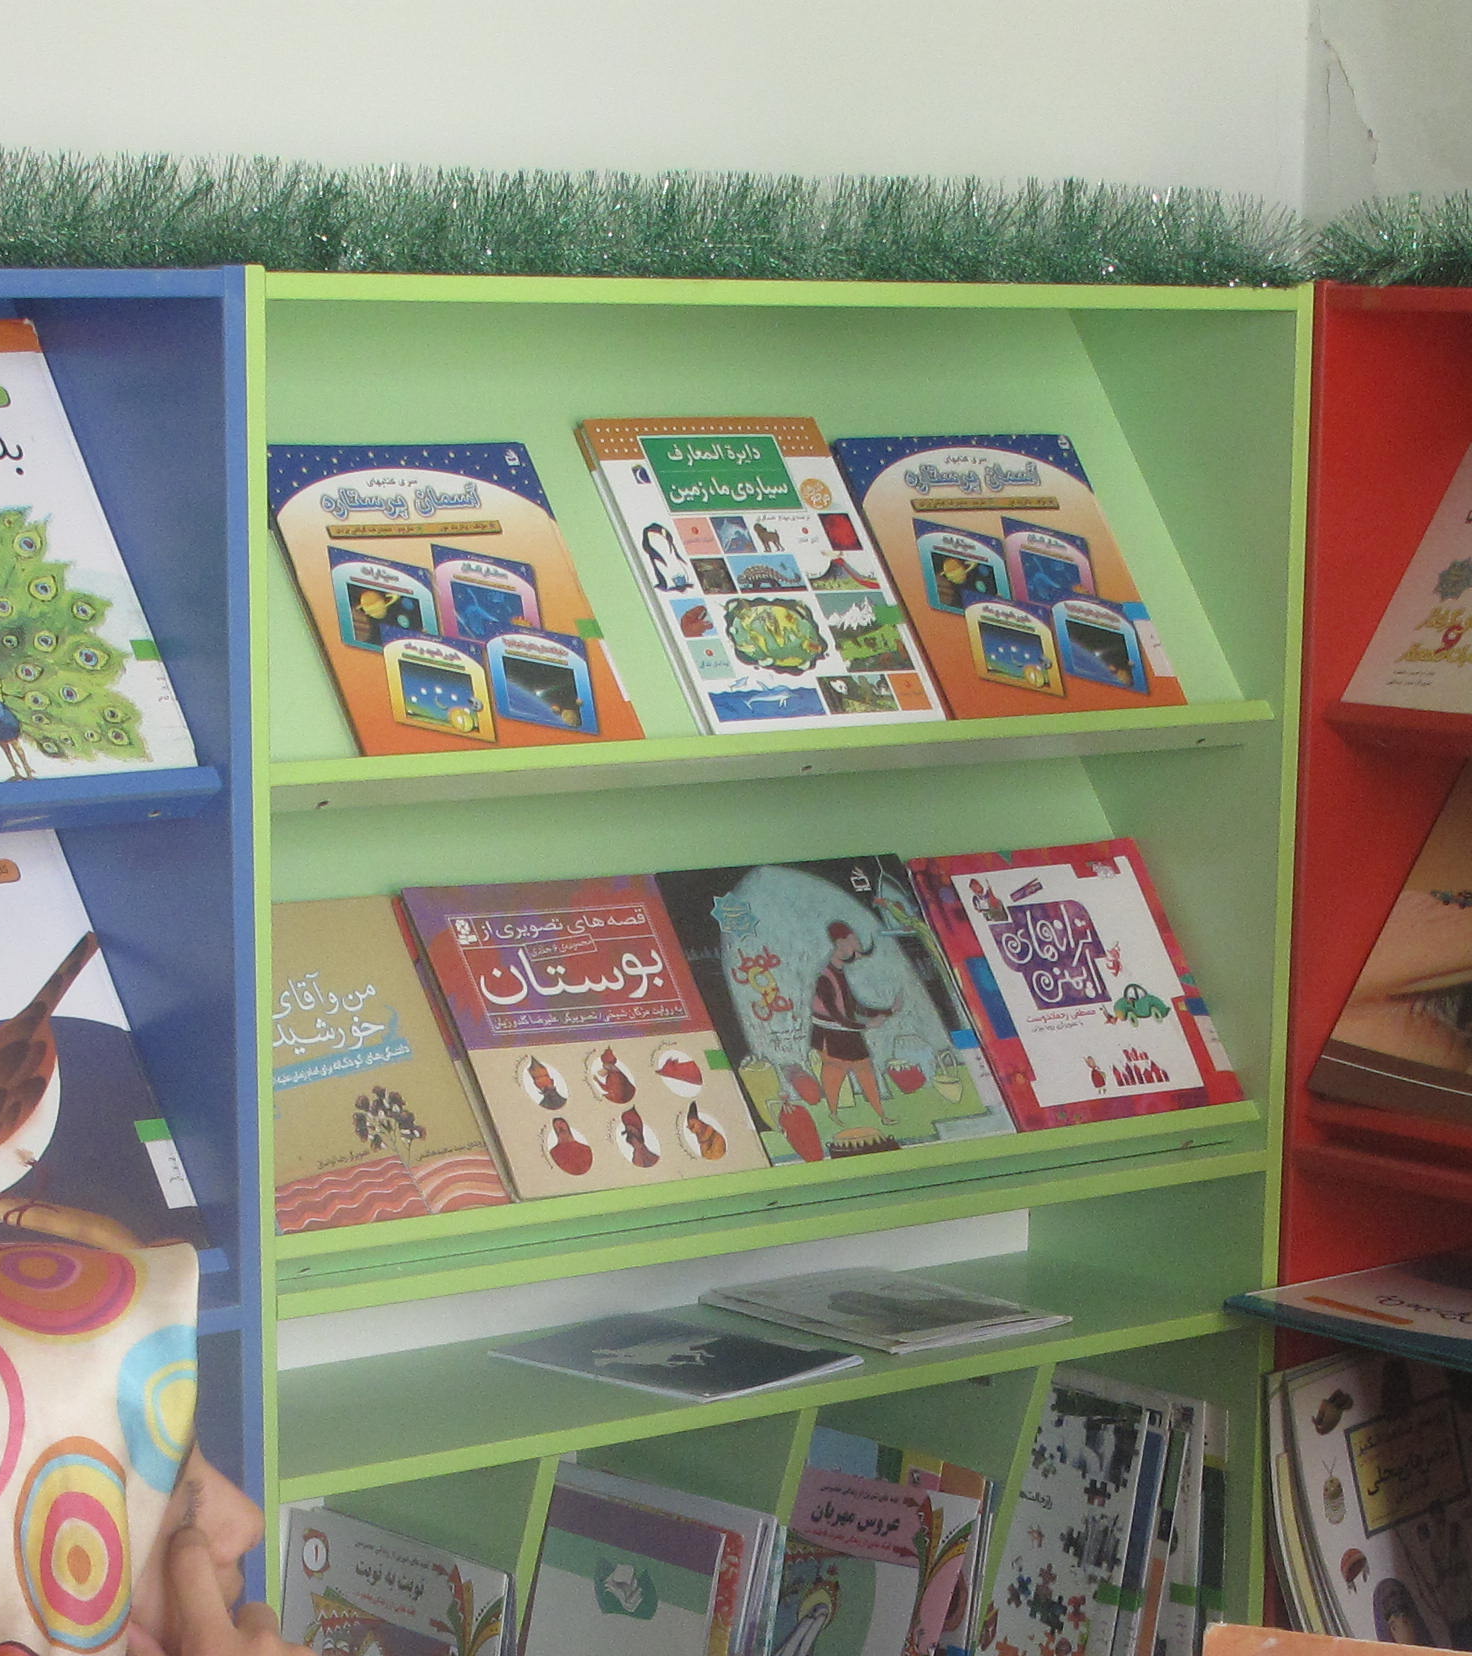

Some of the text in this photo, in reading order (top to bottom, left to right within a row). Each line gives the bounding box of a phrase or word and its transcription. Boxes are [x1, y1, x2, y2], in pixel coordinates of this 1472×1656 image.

[667, 443, 725, 466] المعارف
[414, 480, 482, 518] آسمان
[669, 480, 709, 503] زمین
[495, 917, 564, 941] تصویری
[606, 908, 647, 928] قصه
[480, 920, 493, 942] از
[480, 947, 666, 1006] بوستان
[272, 971, 377, 1020] من و آقای
[272, 1016, 385, 1055] خورشید
